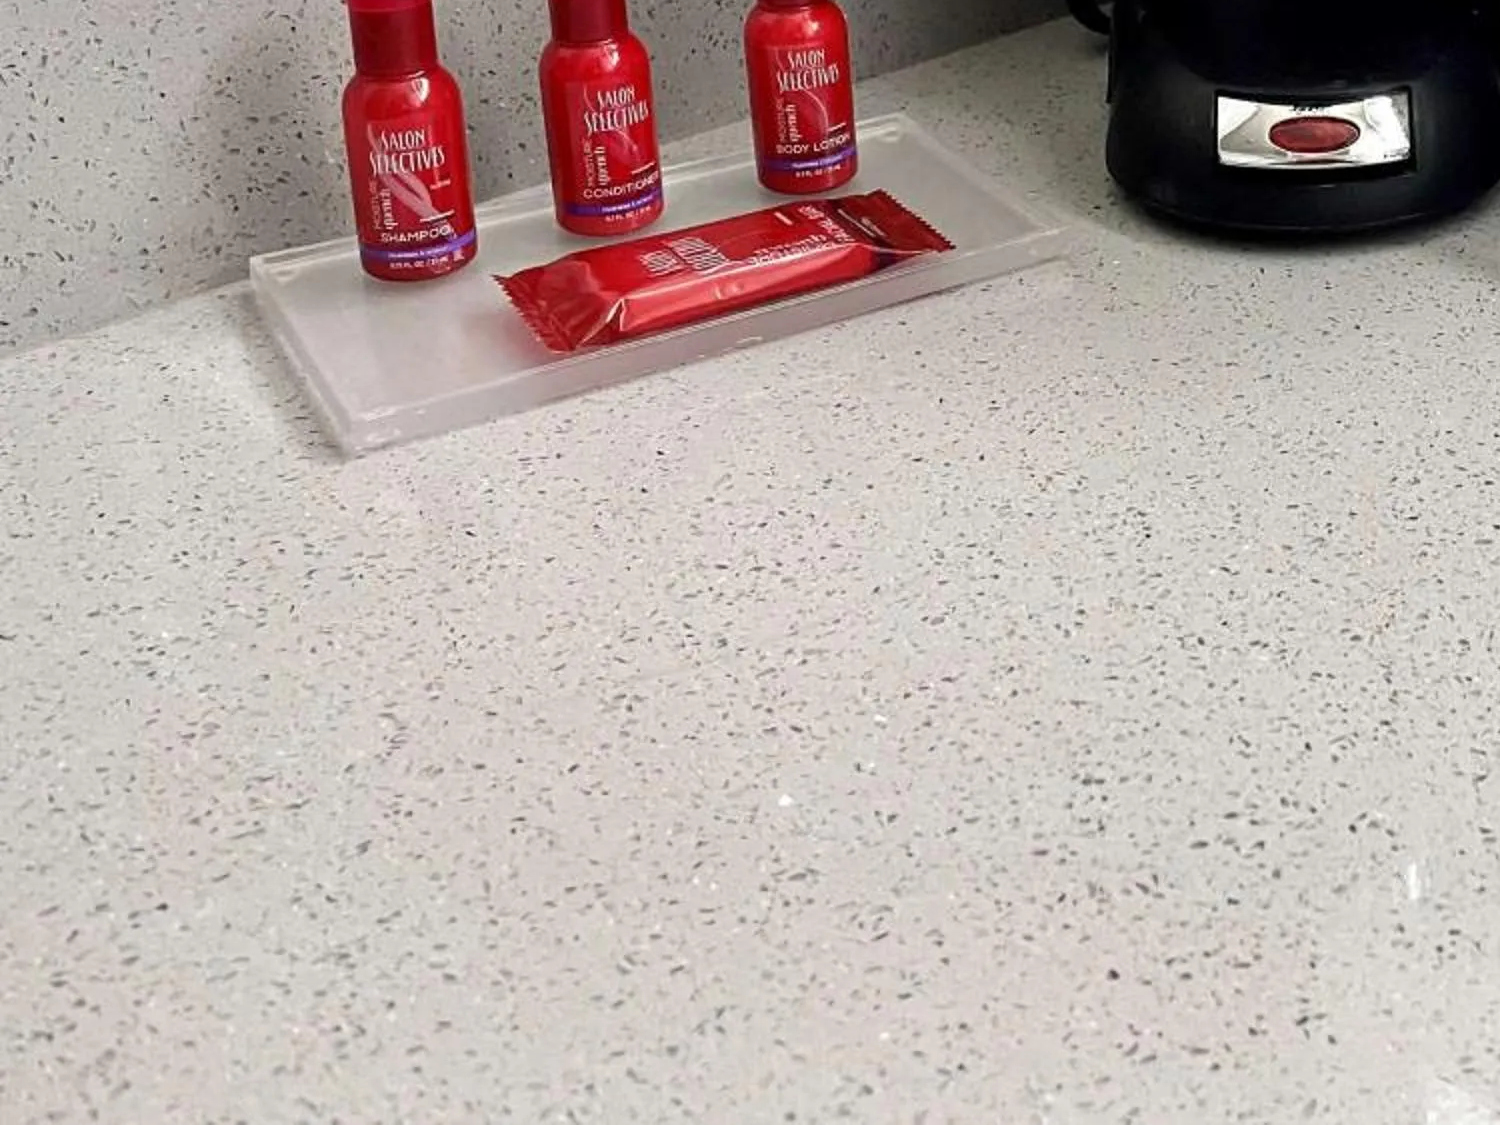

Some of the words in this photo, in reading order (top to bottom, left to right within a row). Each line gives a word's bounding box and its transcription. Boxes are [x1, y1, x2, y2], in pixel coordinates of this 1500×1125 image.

[788, 48, 825, 69] SALON
[597, 84, 635, 109] SALON
[381, 129, 426, 152] SALON
[369, 145, 446, 178] SELECTIVES
[381, 224, 452, 243] SHAMPOO
